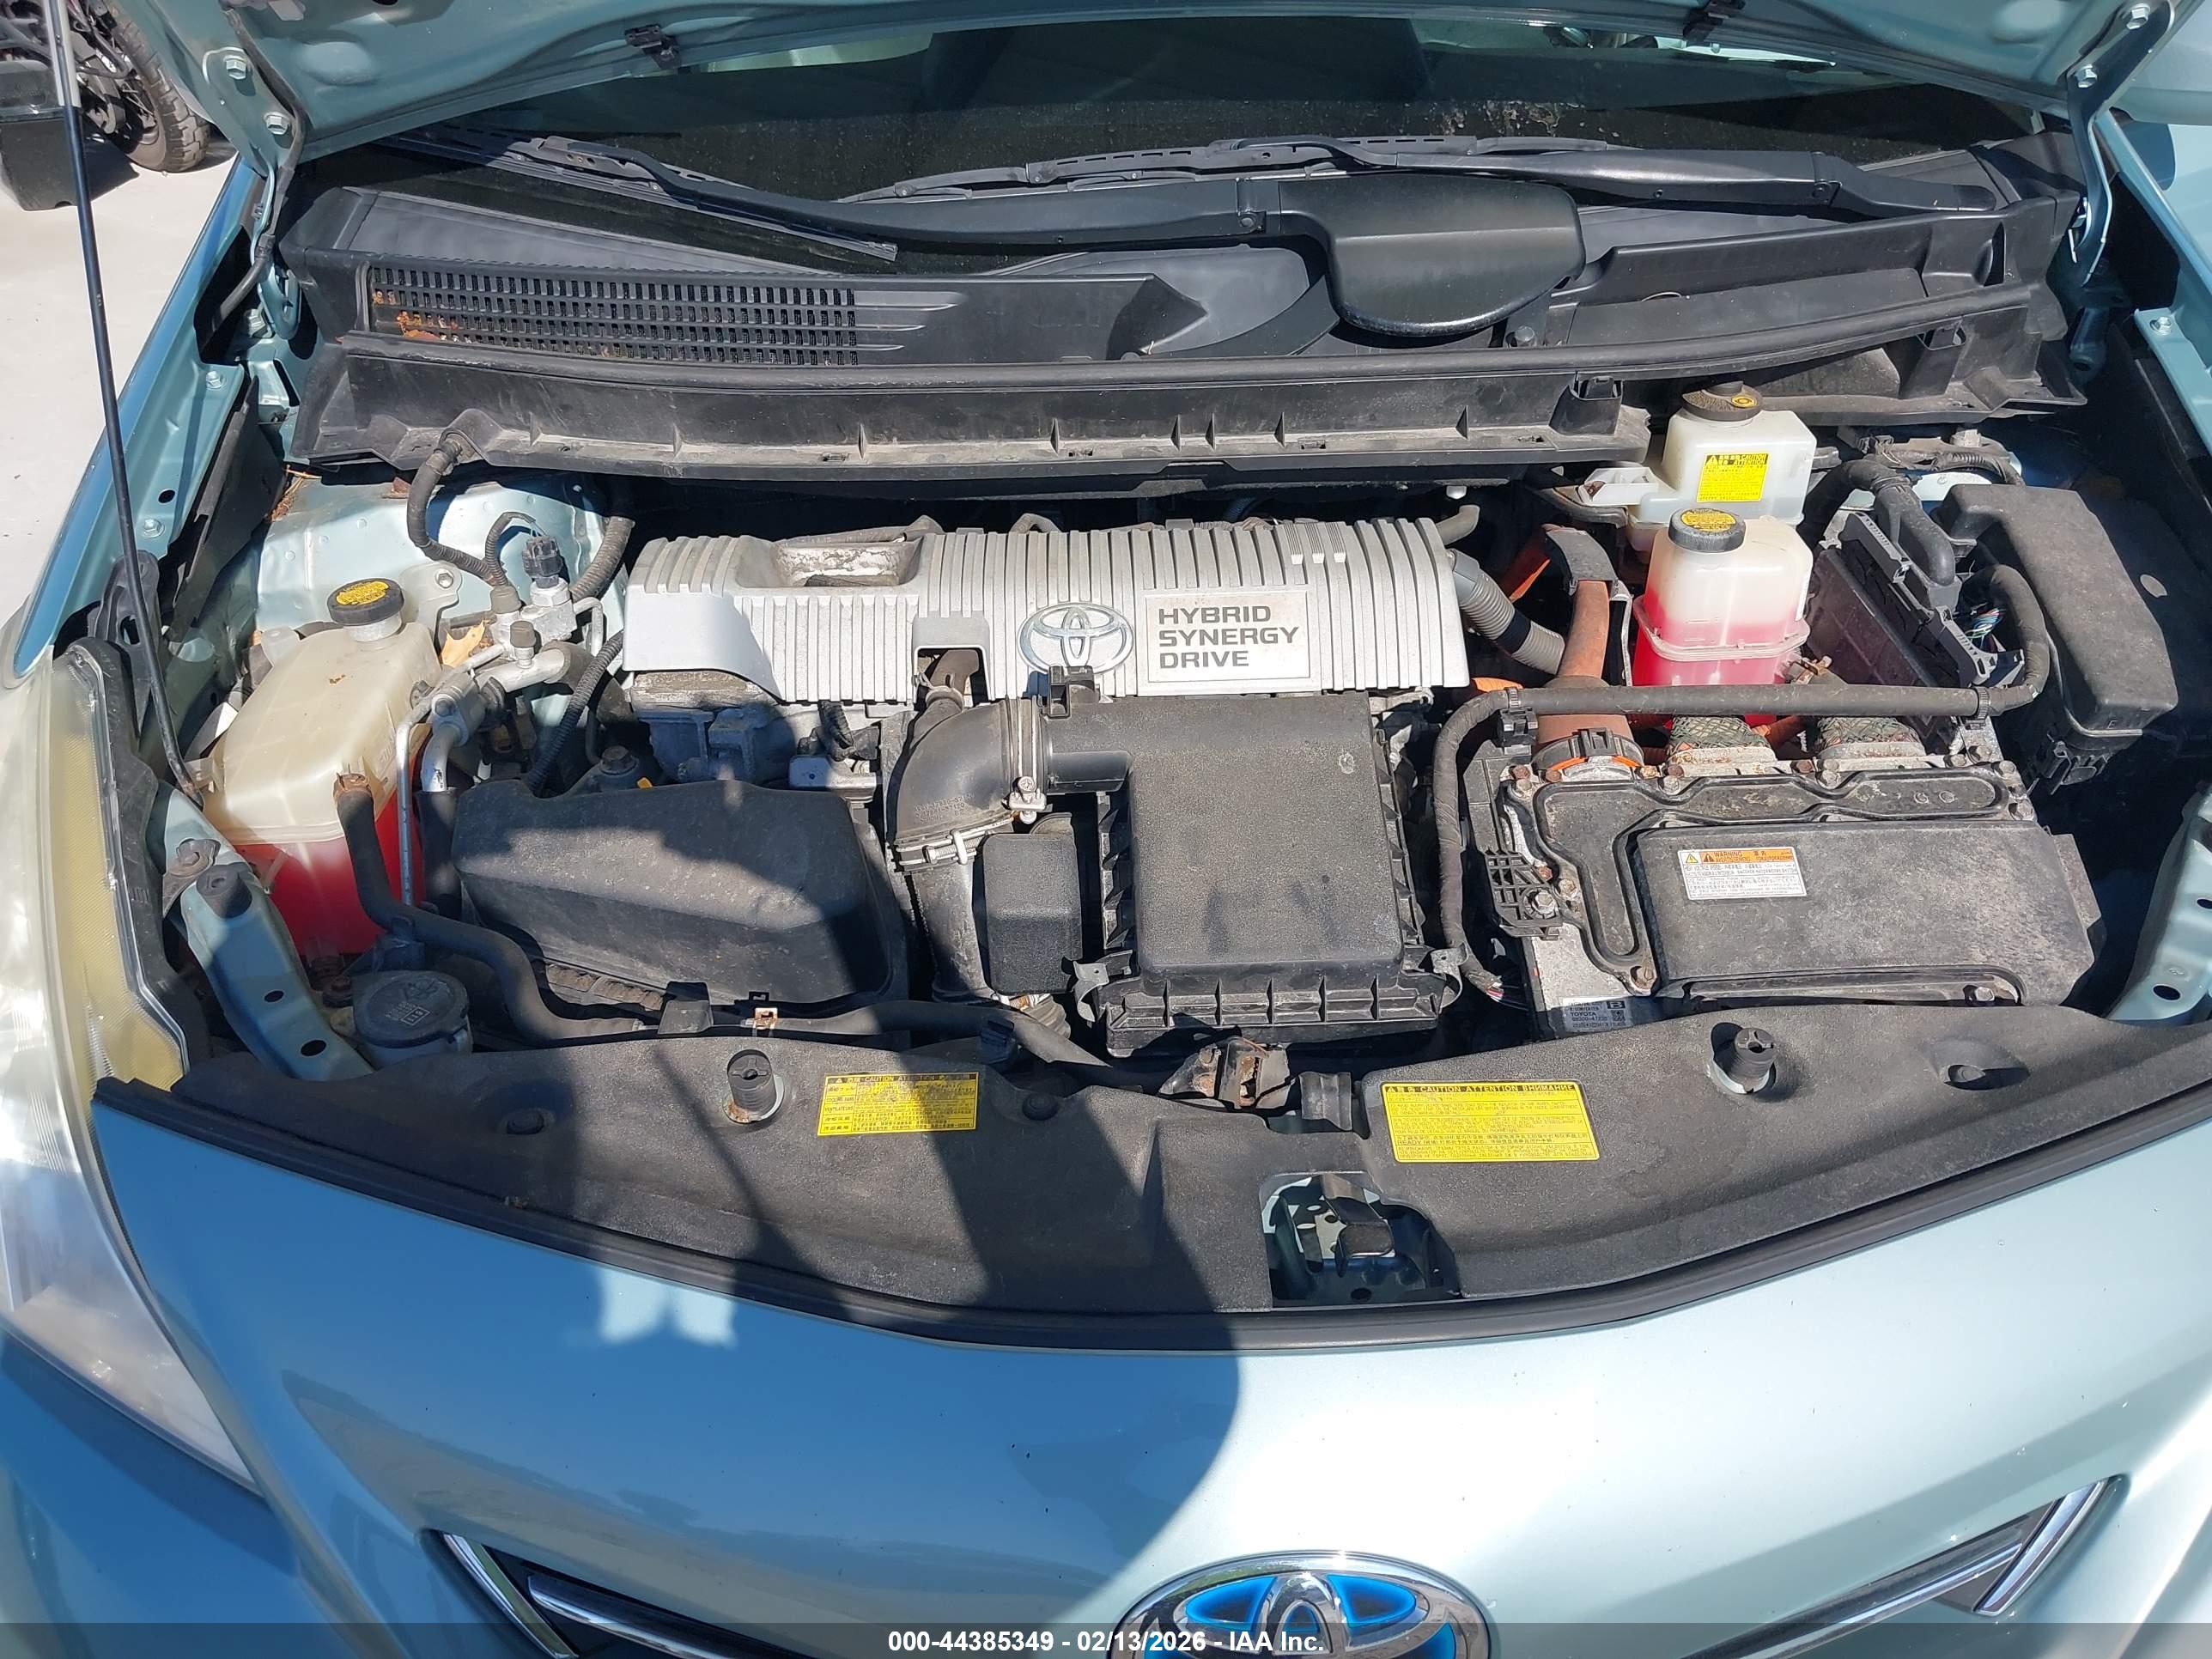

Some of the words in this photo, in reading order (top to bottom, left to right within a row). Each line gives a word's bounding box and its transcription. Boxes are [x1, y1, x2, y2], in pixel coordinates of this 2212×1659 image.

[1158, 605, 1272, 625] HYBRID
[1158, 626, 1299, 647] SYNERGY
[1159, 650, 1249, 669] DRIVE
